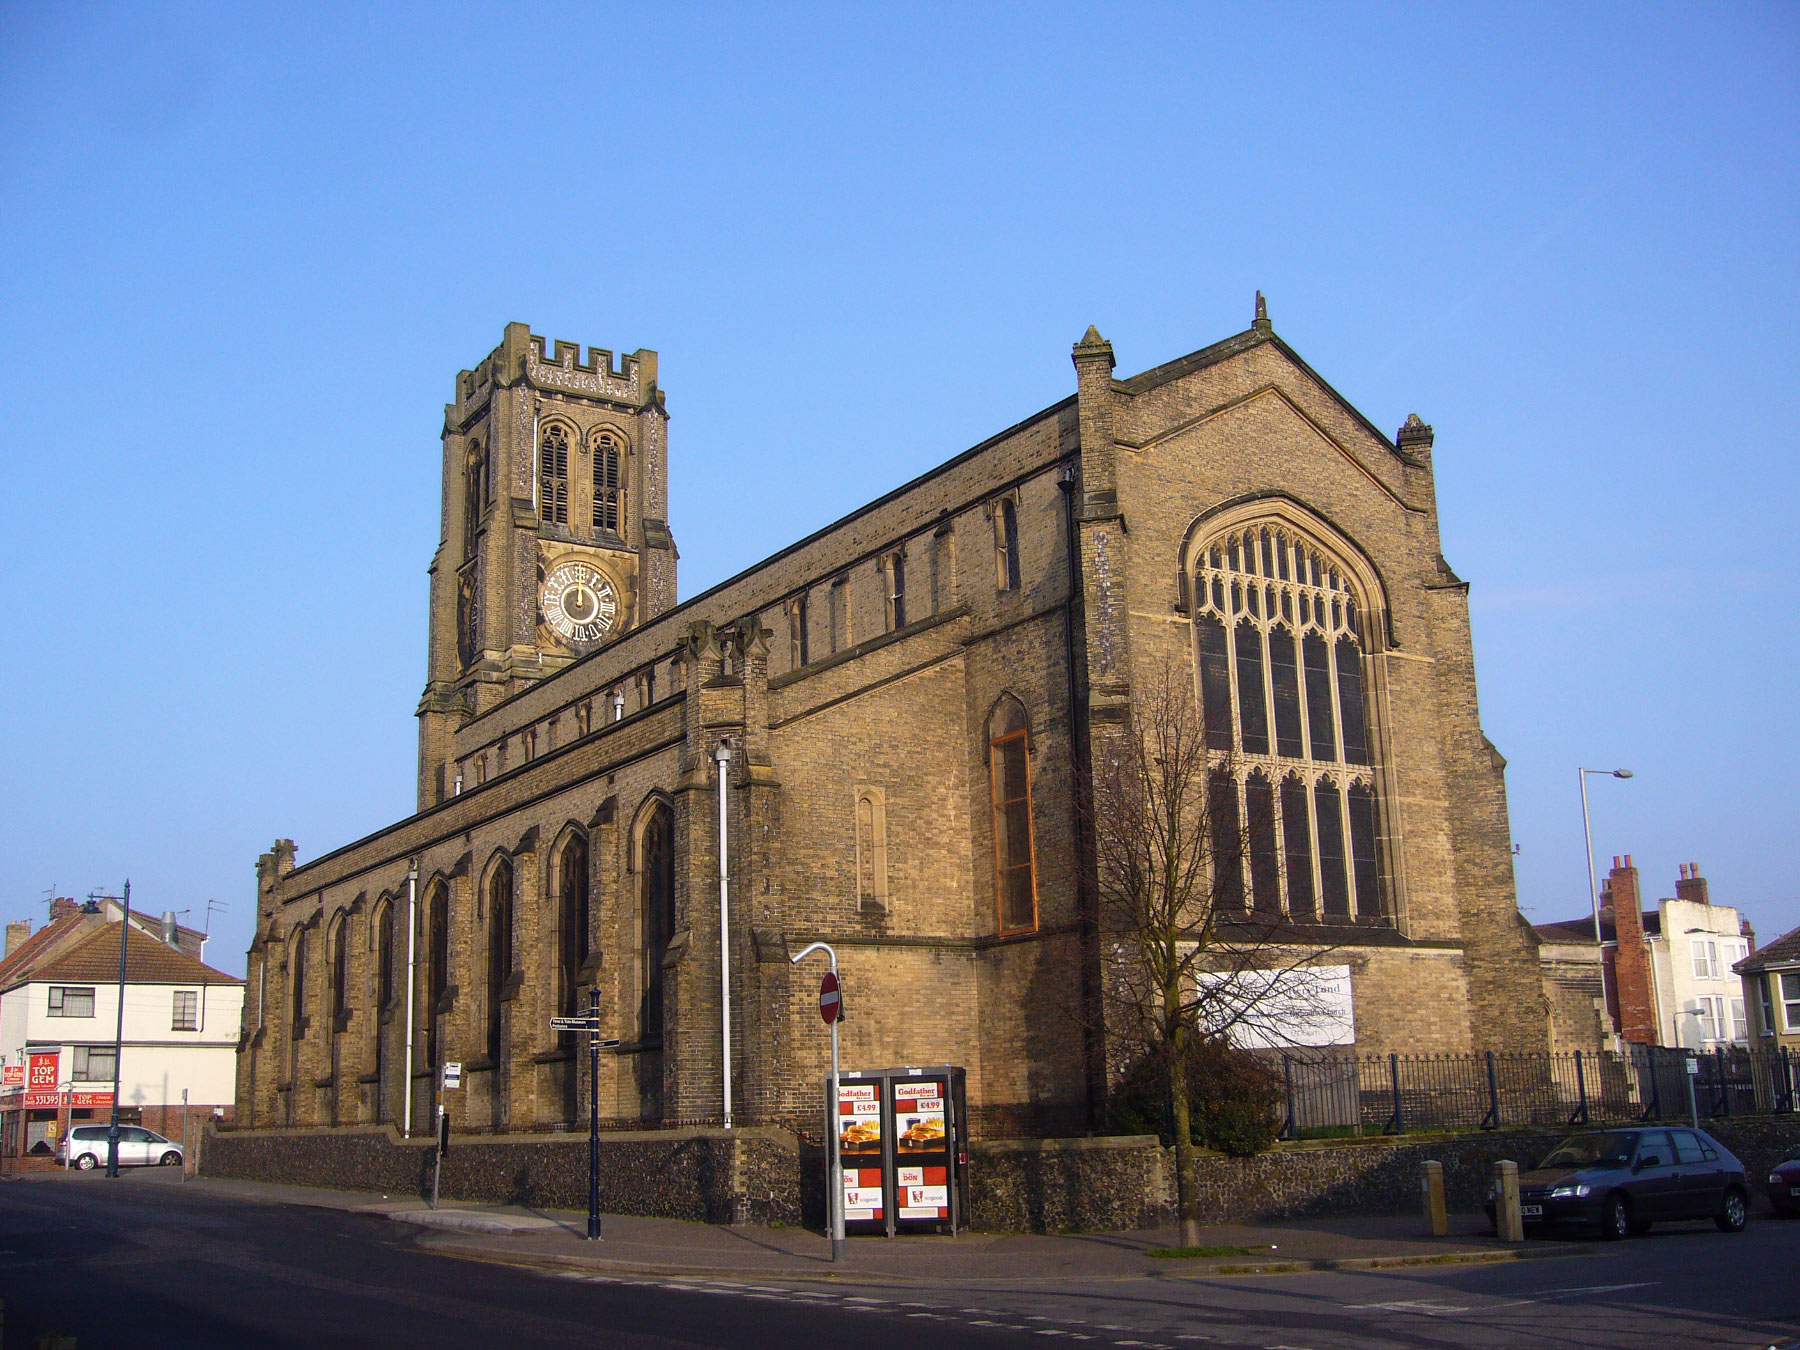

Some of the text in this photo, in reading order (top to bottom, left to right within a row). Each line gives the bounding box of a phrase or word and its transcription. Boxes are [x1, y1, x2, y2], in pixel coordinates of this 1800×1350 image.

[32, 1066, 55, 1075] TOP
[31, 1075, 55, 1084] GEM
[838, 1090, 872, 1098] odfather
